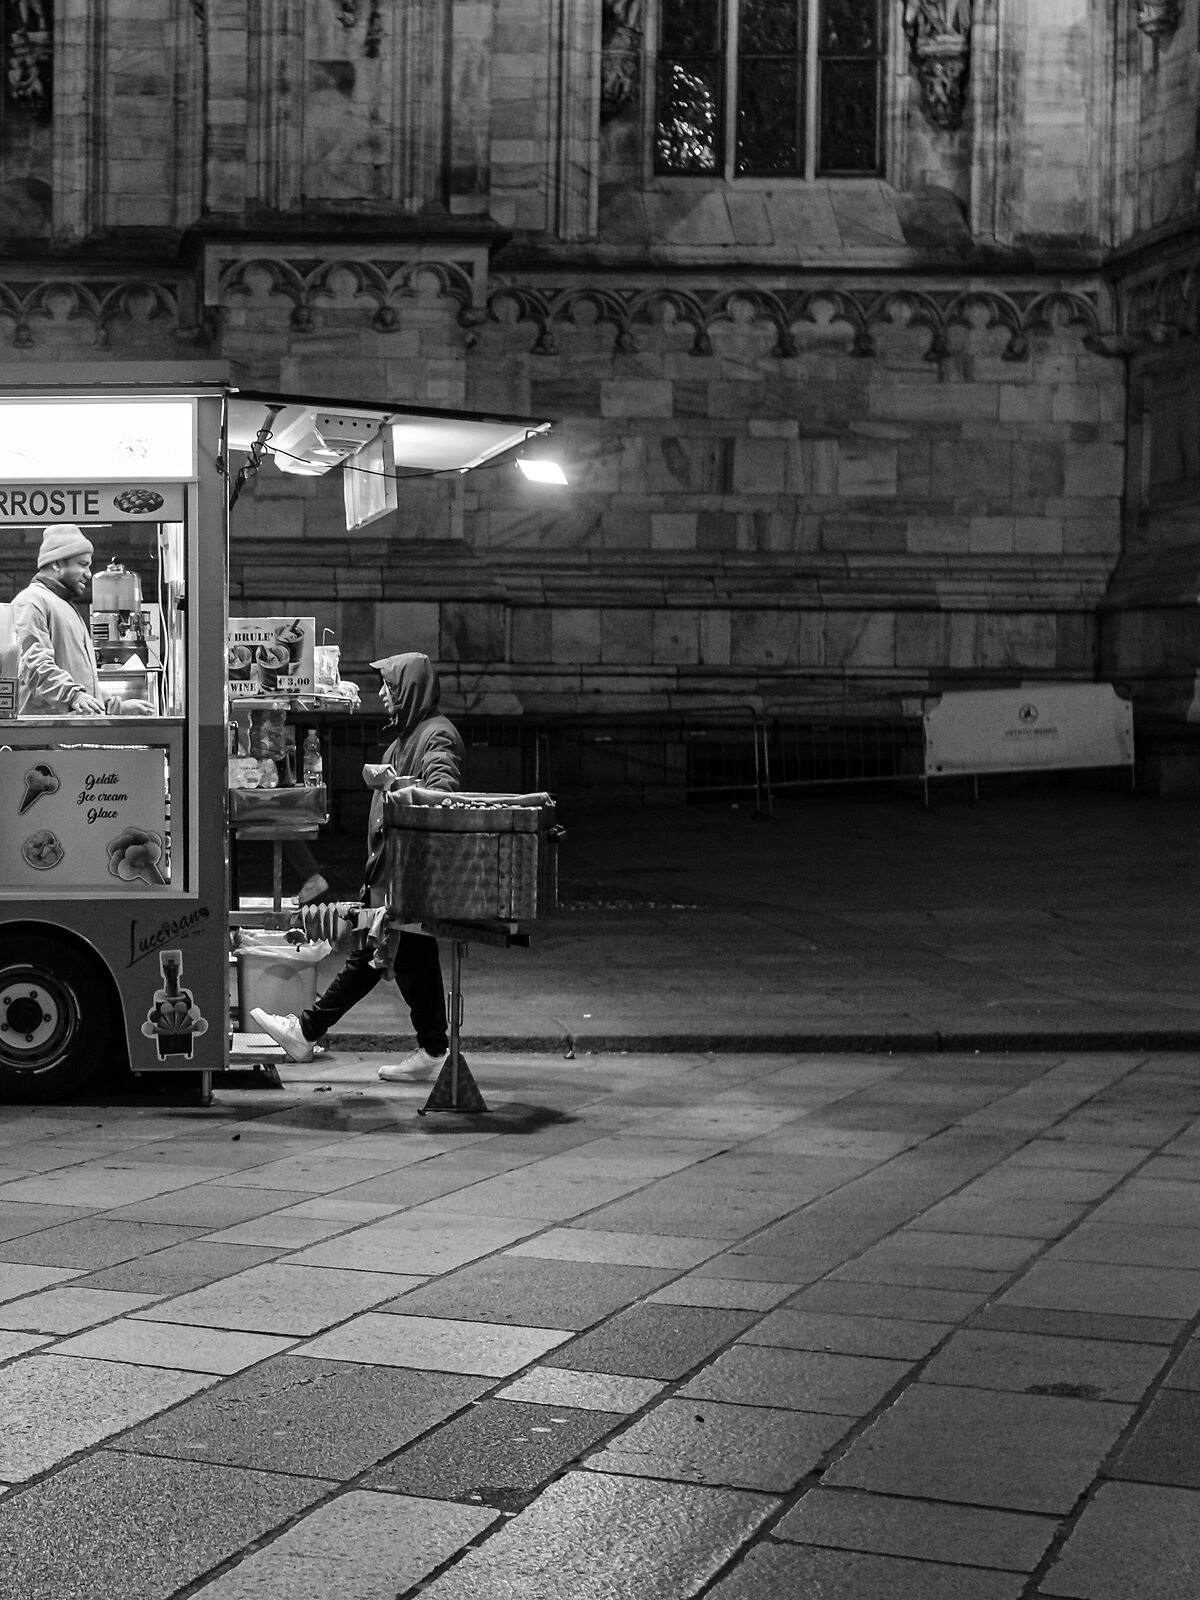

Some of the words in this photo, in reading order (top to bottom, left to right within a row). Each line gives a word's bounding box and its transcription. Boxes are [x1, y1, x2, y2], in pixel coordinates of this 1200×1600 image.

[234, 632, 274, 642] BRULE'
[230, 682, 256, 692] WINE
[84, 773, 120, 790] Gelato
[76, 790, 96, 806] Ice
[96, 790, 129, 802] cream
[86, 807, 119, 824] Glace
